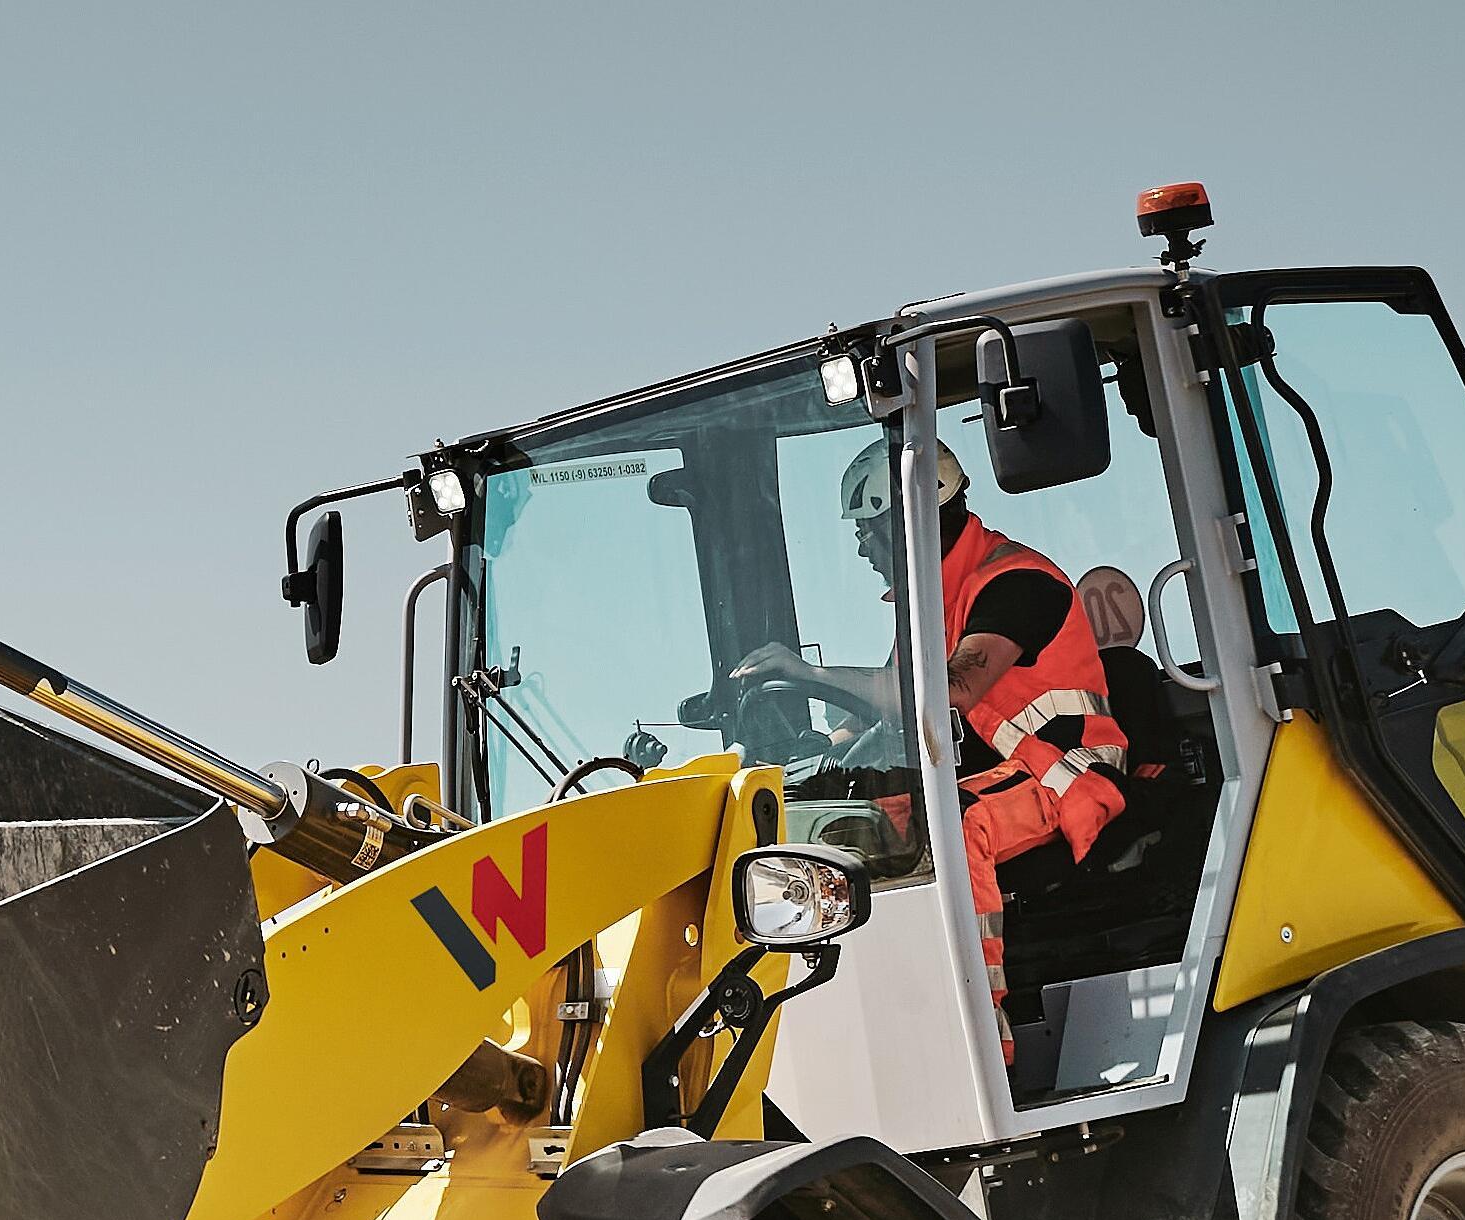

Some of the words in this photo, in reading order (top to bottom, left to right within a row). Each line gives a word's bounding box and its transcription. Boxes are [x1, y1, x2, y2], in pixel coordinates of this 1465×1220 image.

[550, 471, 570, 482] 1150
[572, 469, 586, 480] (-9)
[618, 463, 646, 475] 1-0382
